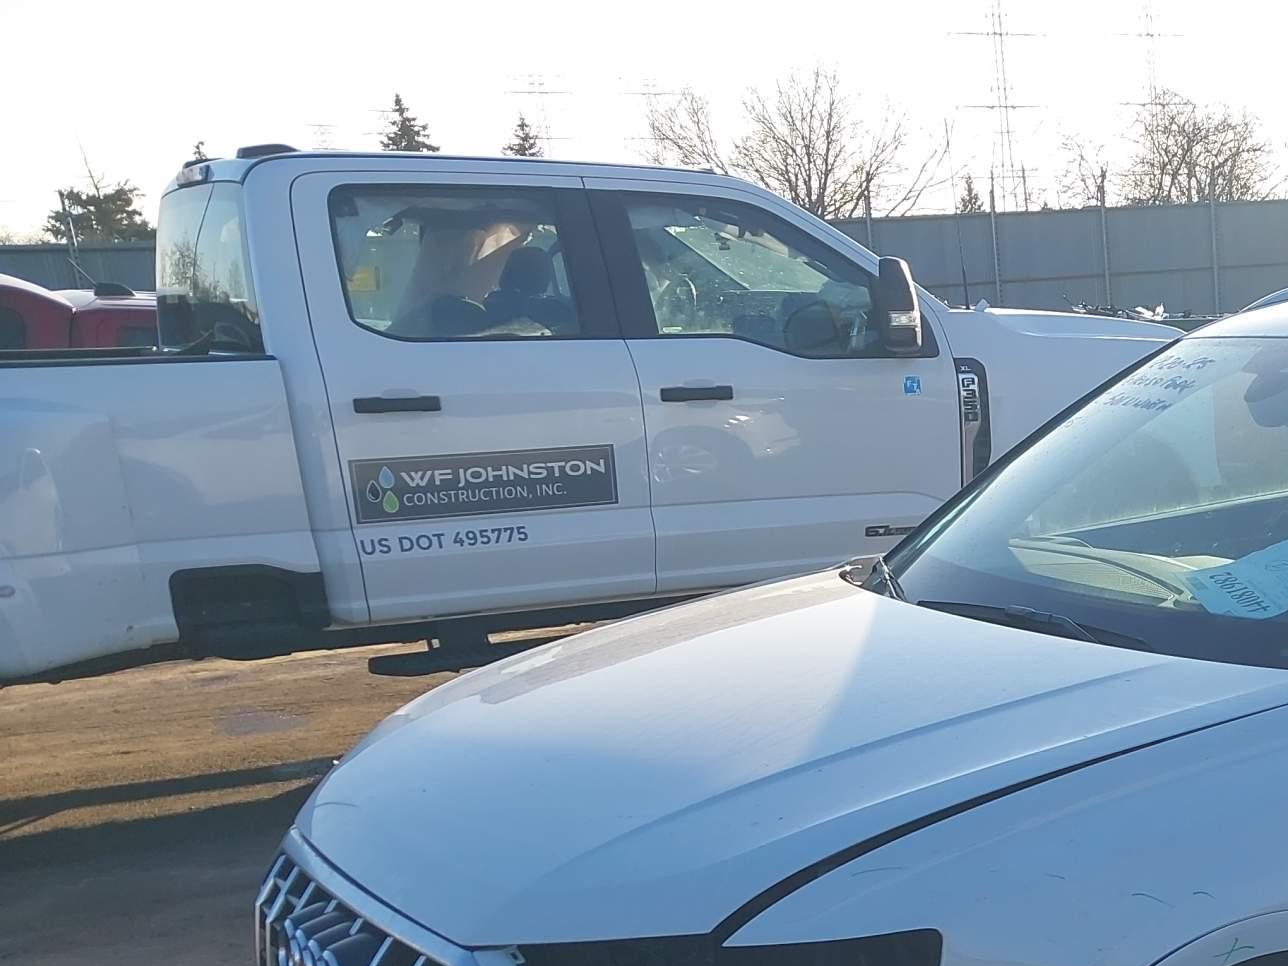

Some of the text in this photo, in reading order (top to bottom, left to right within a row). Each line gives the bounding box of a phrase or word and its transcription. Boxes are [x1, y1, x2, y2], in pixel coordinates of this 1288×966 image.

[400, 459, 606, 488] WF JOHNSTON
[403, 482, 568, 506] CONSTRUCTION, INC.
[360, 525, 529, 556] US DOT 495775
[1209, 571, 1272, 613] 44081982
